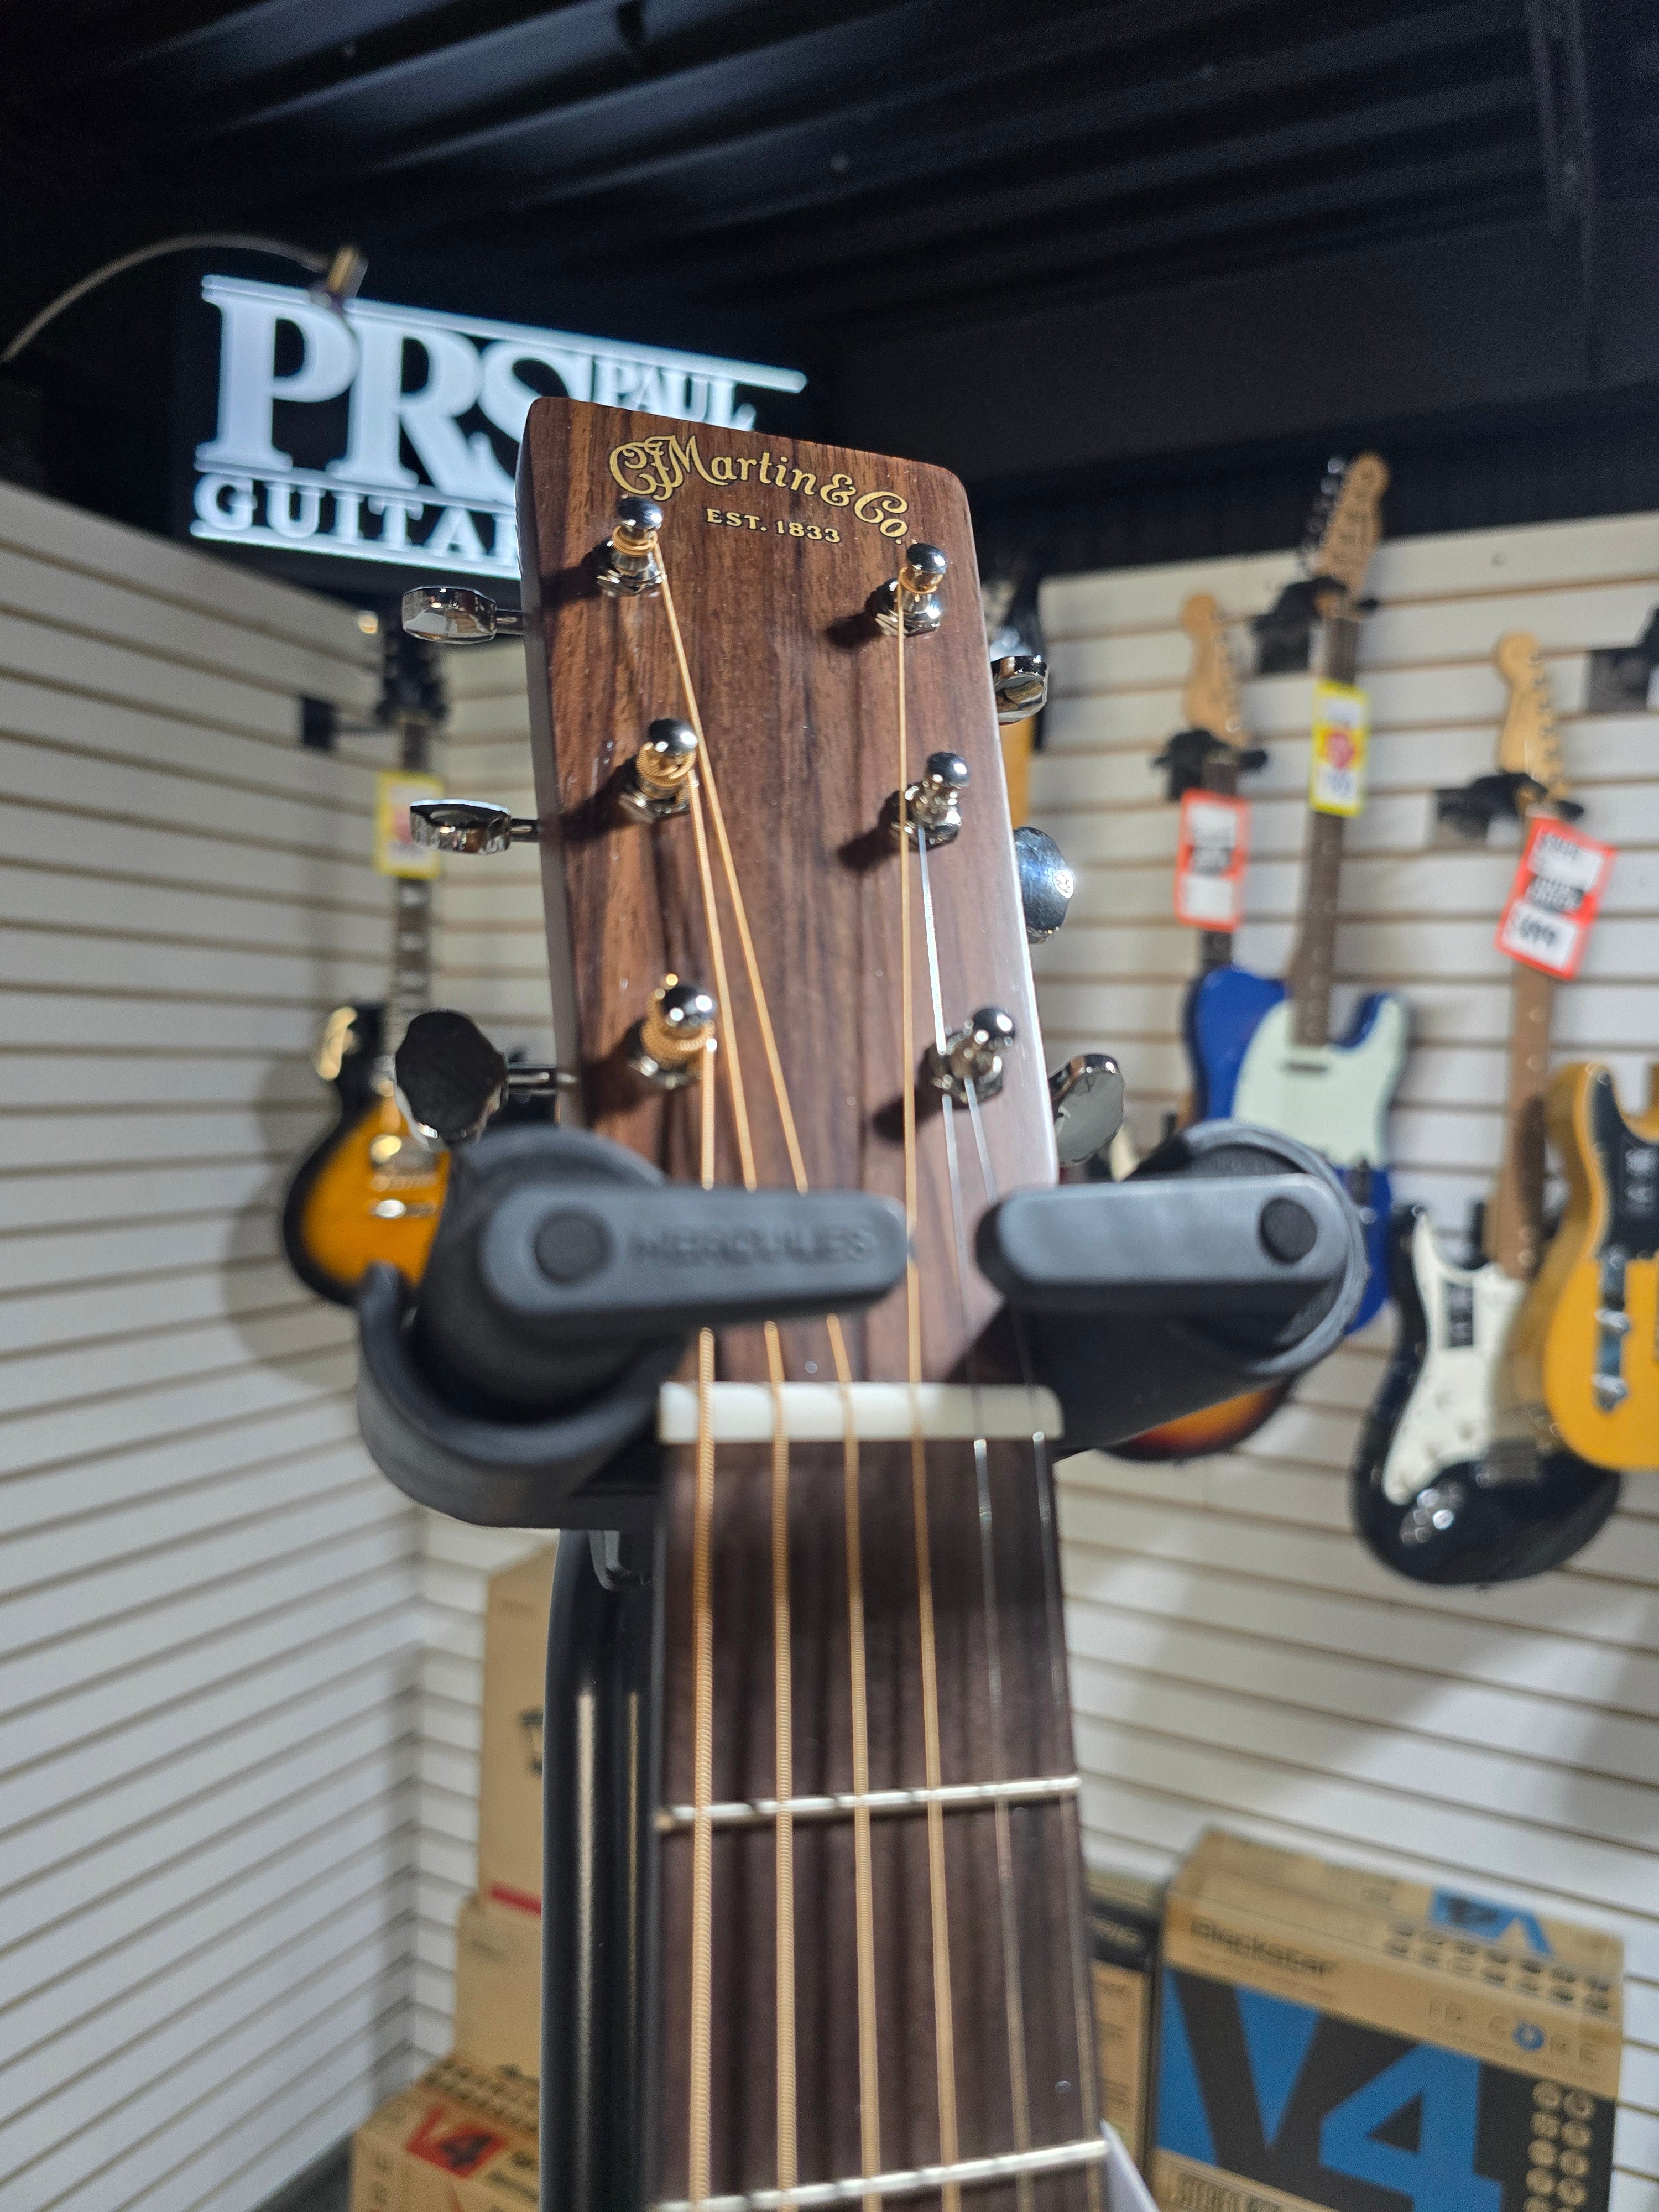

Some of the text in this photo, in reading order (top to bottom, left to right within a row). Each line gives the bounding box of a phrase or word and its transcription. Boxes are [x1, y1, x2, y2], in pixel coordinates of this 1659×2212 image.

[195, 275, 593, 507] PRS
[706, 507, 841, 543] EST. 1833
